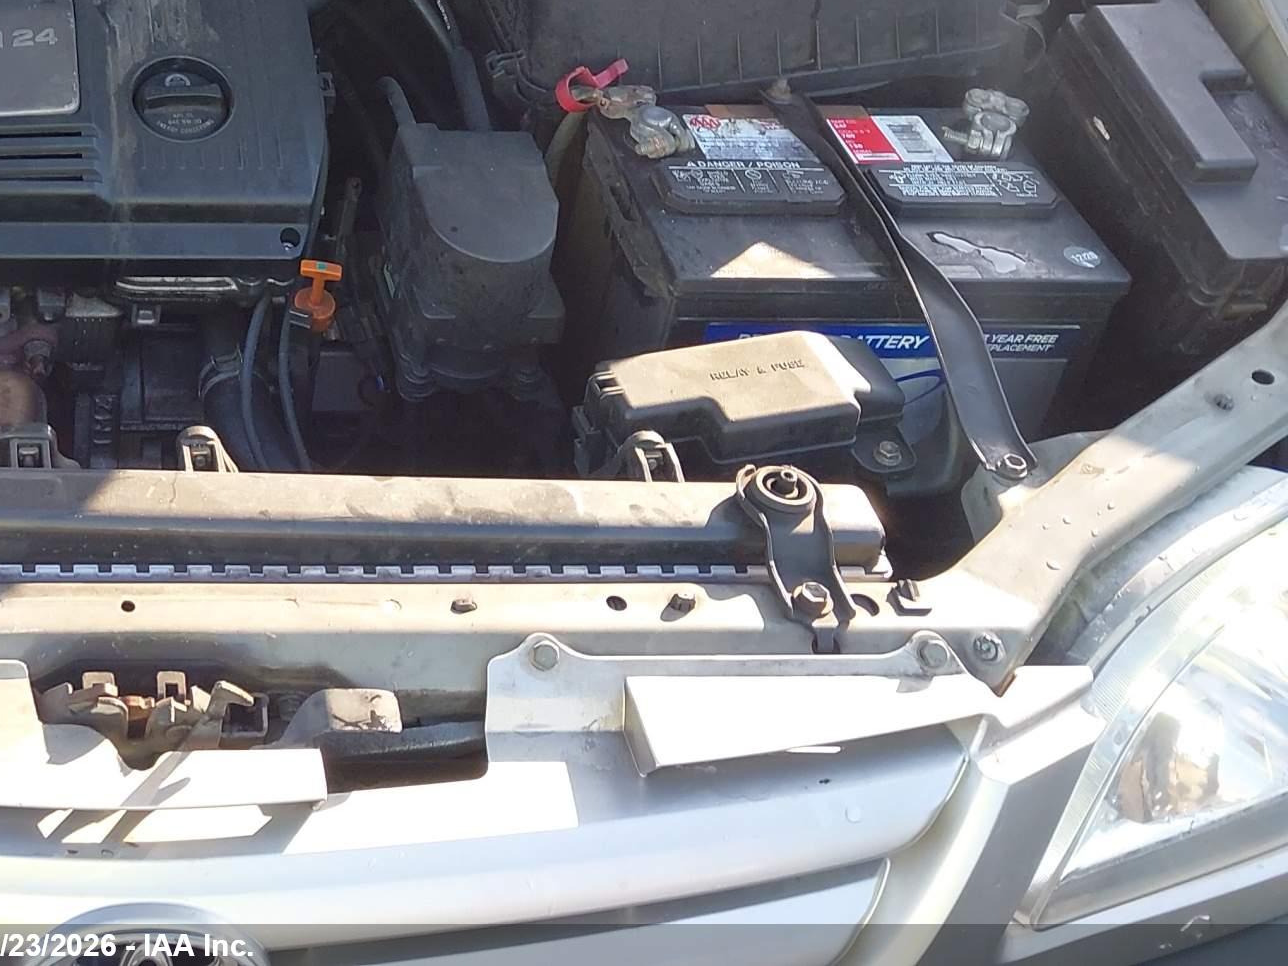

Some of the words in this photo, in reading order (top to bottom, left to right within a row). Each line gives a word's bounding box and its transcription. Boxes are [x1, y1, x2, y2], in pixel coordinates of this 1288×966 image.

[12, 28, 59, 47] 24
[756, 161, 801, 169] POISON
[992, 334, 1025, 343] YEAR
[1024, 334, 1059, 344] FREE
